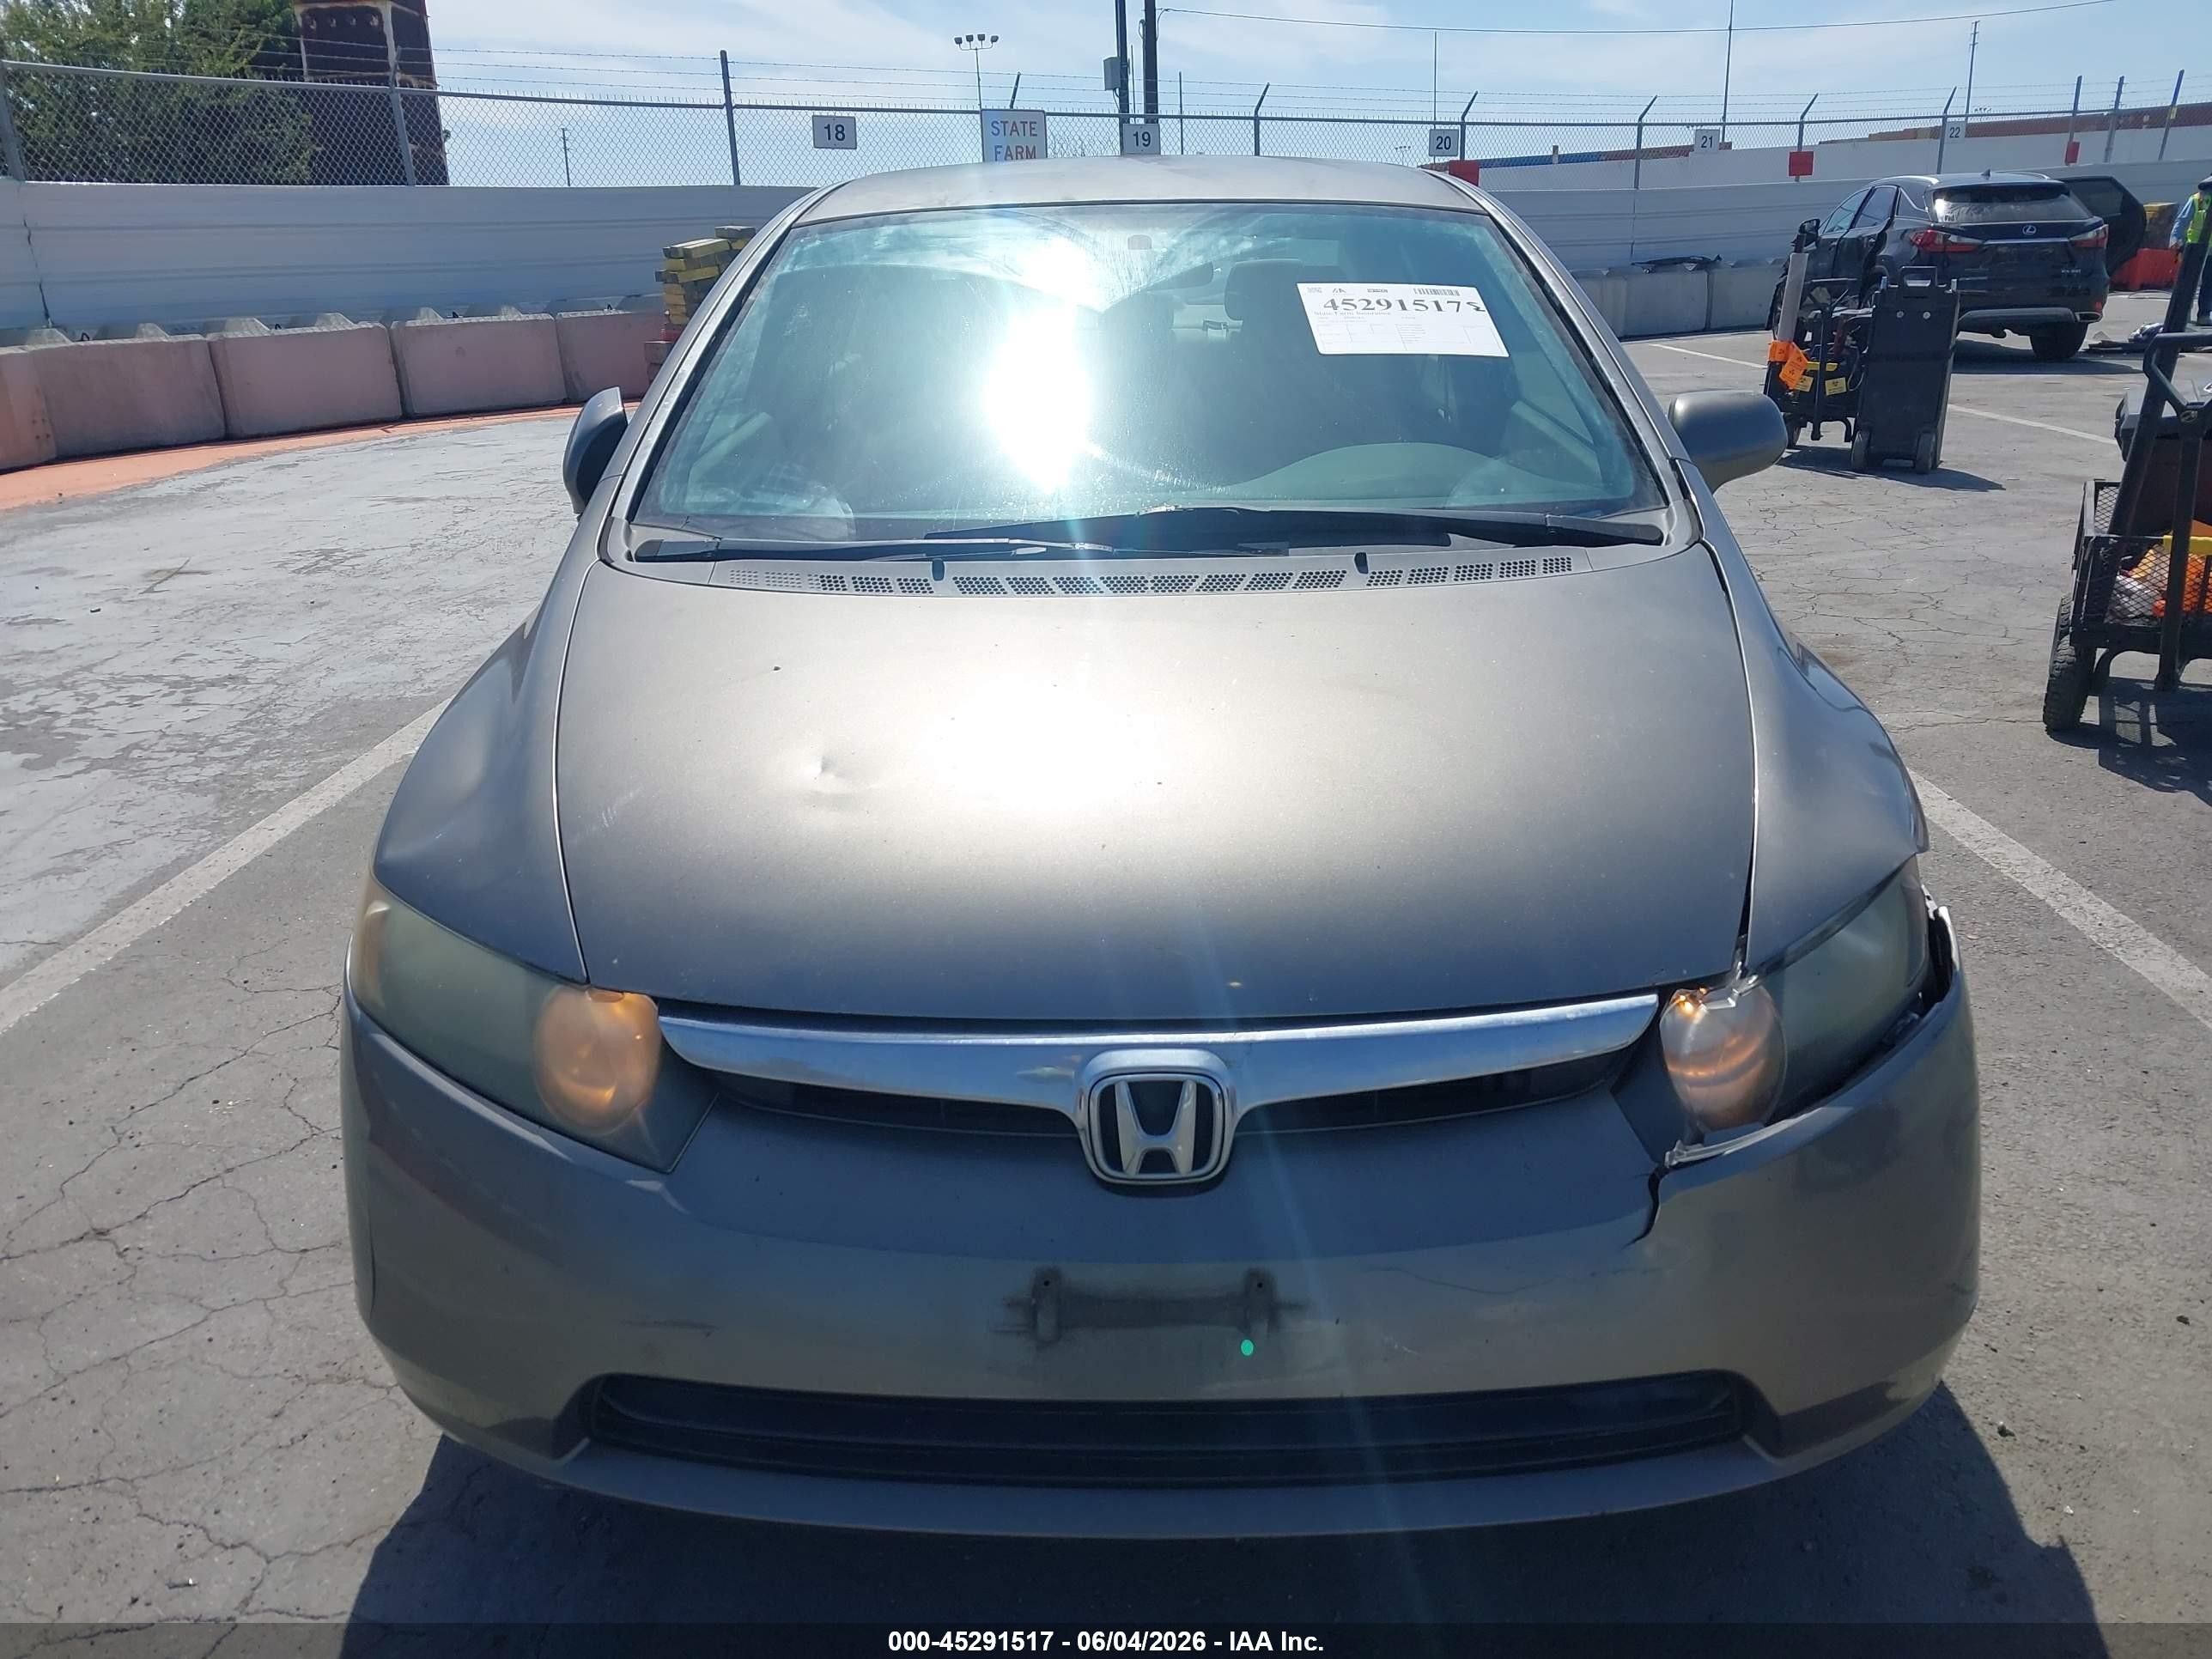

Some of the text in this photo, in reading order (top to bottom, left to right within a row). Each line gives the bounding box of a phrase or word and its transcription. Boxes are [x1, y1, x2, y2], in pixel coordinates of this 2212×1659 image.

[824, 124, 846, 142] 18
[991, 120, 1038, 137] STATE
[1949, 126, 1960, 138] 22
[1133, 131, 1152, 147] 19
[1436, 136, 1451, 150] 20
[1700, 135, 1713, 149] 21
[994, 144, 1036, 161] FARM
